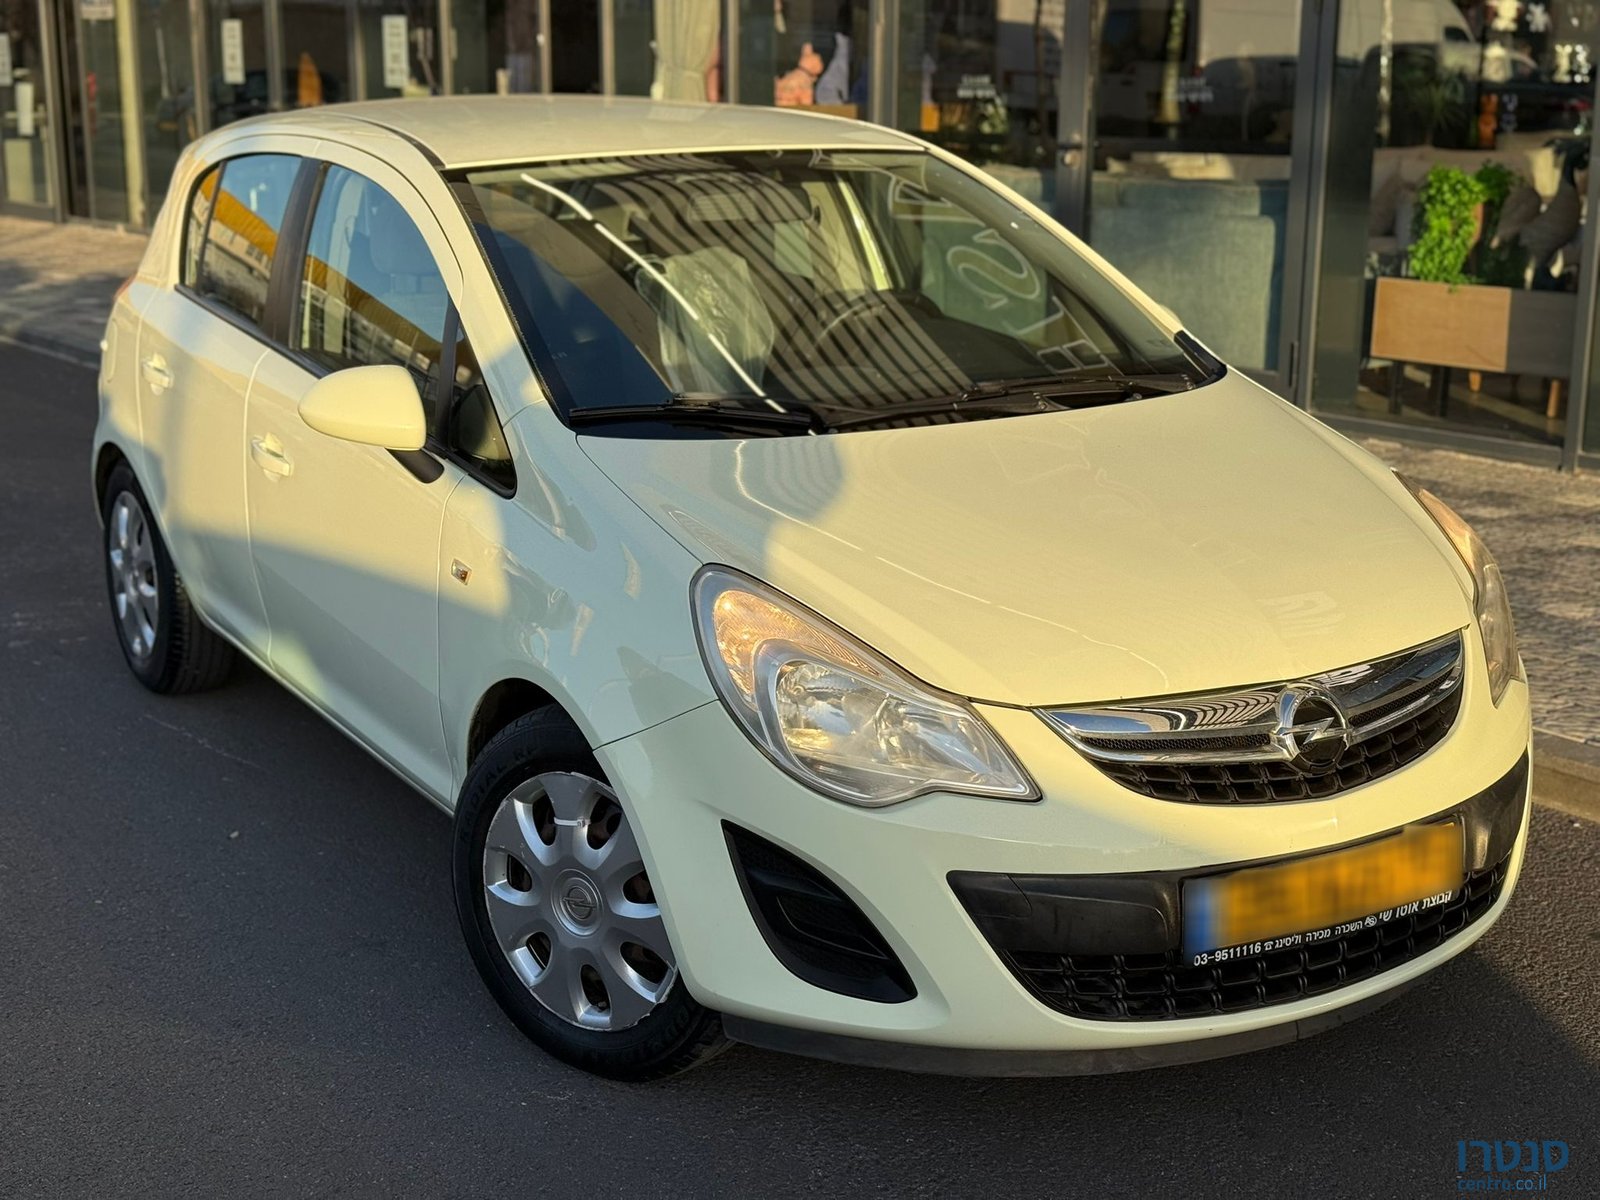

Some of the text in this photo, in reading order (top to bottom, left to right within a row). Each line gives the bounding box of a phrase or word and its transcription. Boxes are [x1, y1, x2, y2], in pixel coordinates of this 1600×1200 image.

[1422, 890, 1453, 909] קבוצת
[1379, 909, 1393, 922] שי
[1395, 900, 1419, 918] אוטו
[1305, 928, 1331, 942] מכירה
[1334, 920, 1363, 935] השכרה
[1274, 934, 1302, 949] וליסינג
[1193, 942, 1262, 966] 03-9511116
